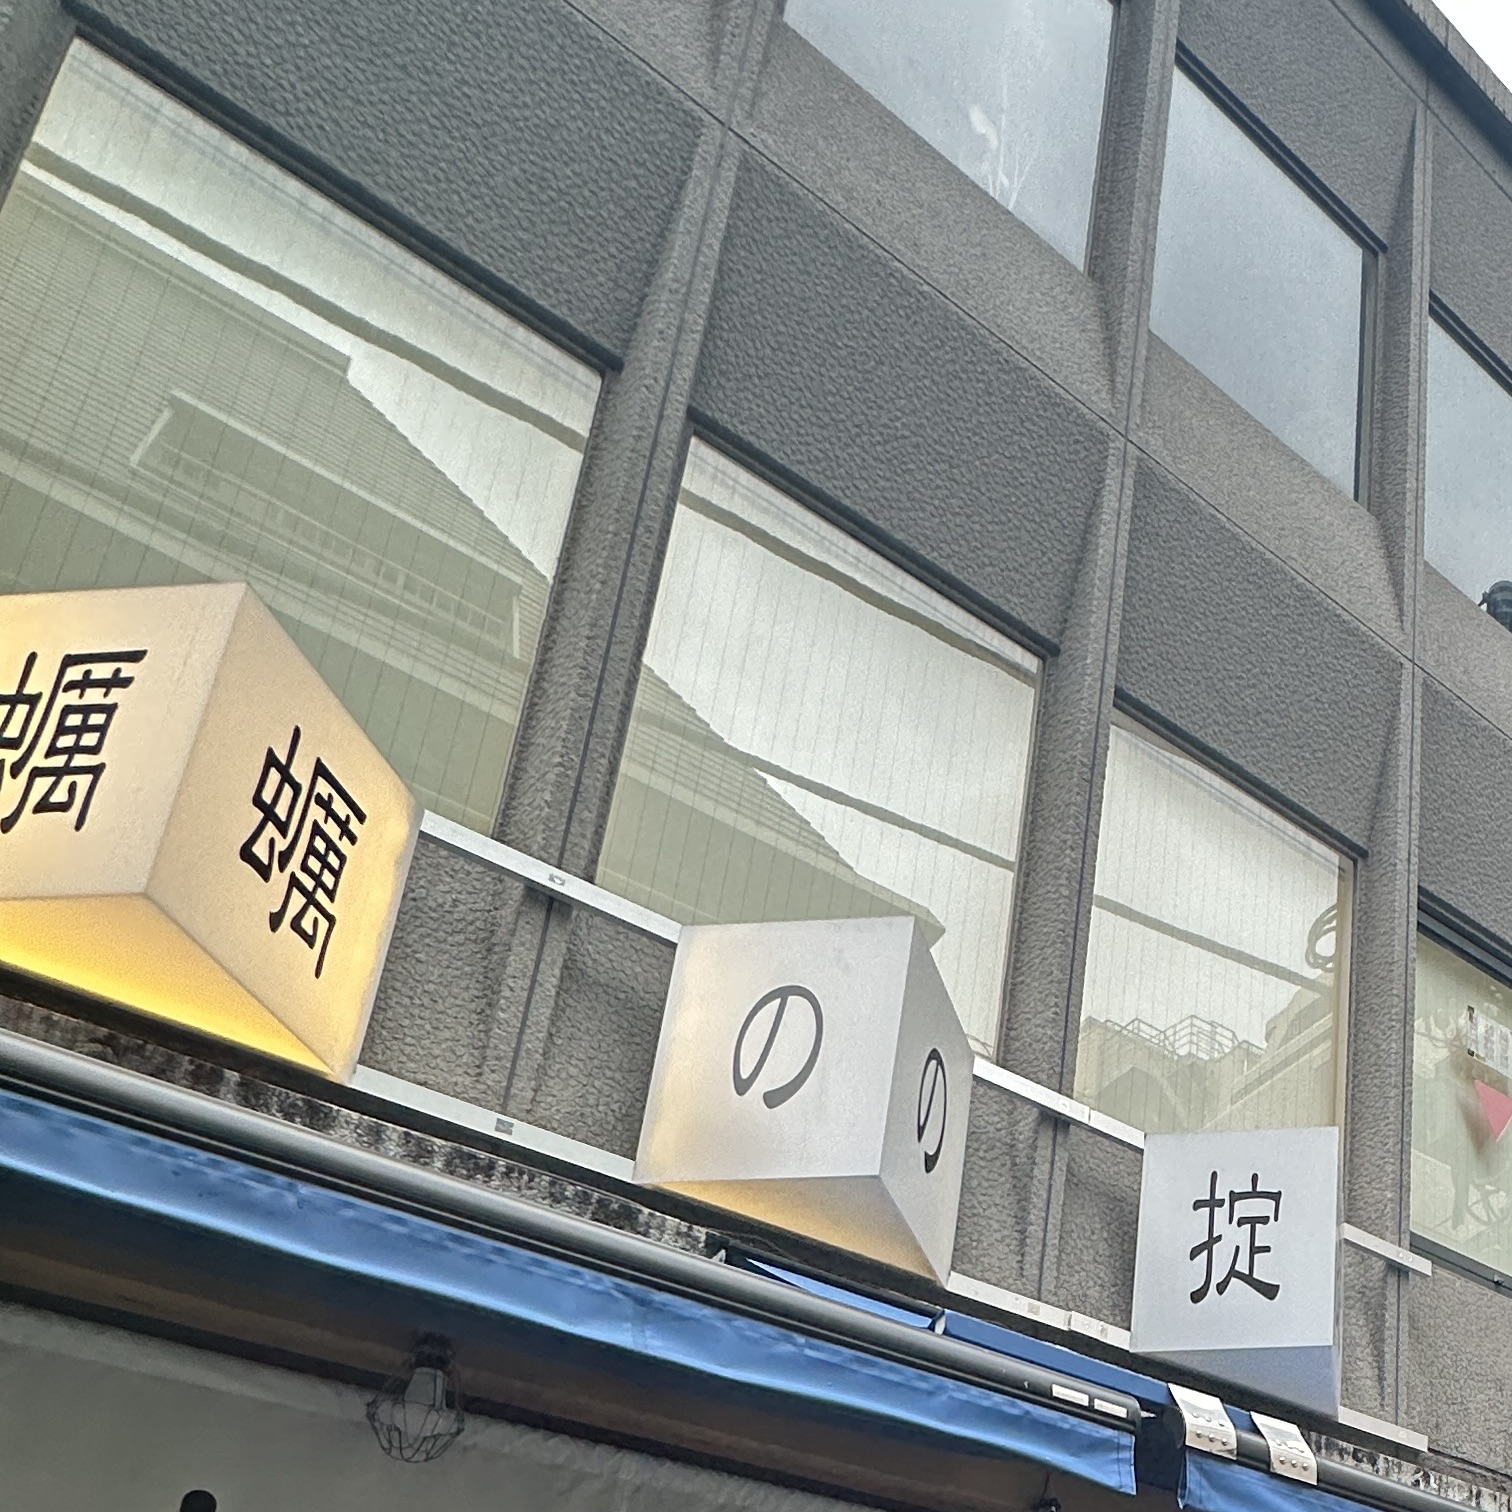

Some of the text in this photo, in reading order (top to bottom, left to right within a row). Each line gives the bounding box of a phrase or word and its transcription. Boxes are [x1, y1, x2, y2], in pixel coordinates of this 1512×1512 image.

[239, 724, 367, 980] 蠣
[732, 984, 824, 1110] の
[917, 1047, 948, 1175] の
[1189, 1171, 1283, 1305] 掟
